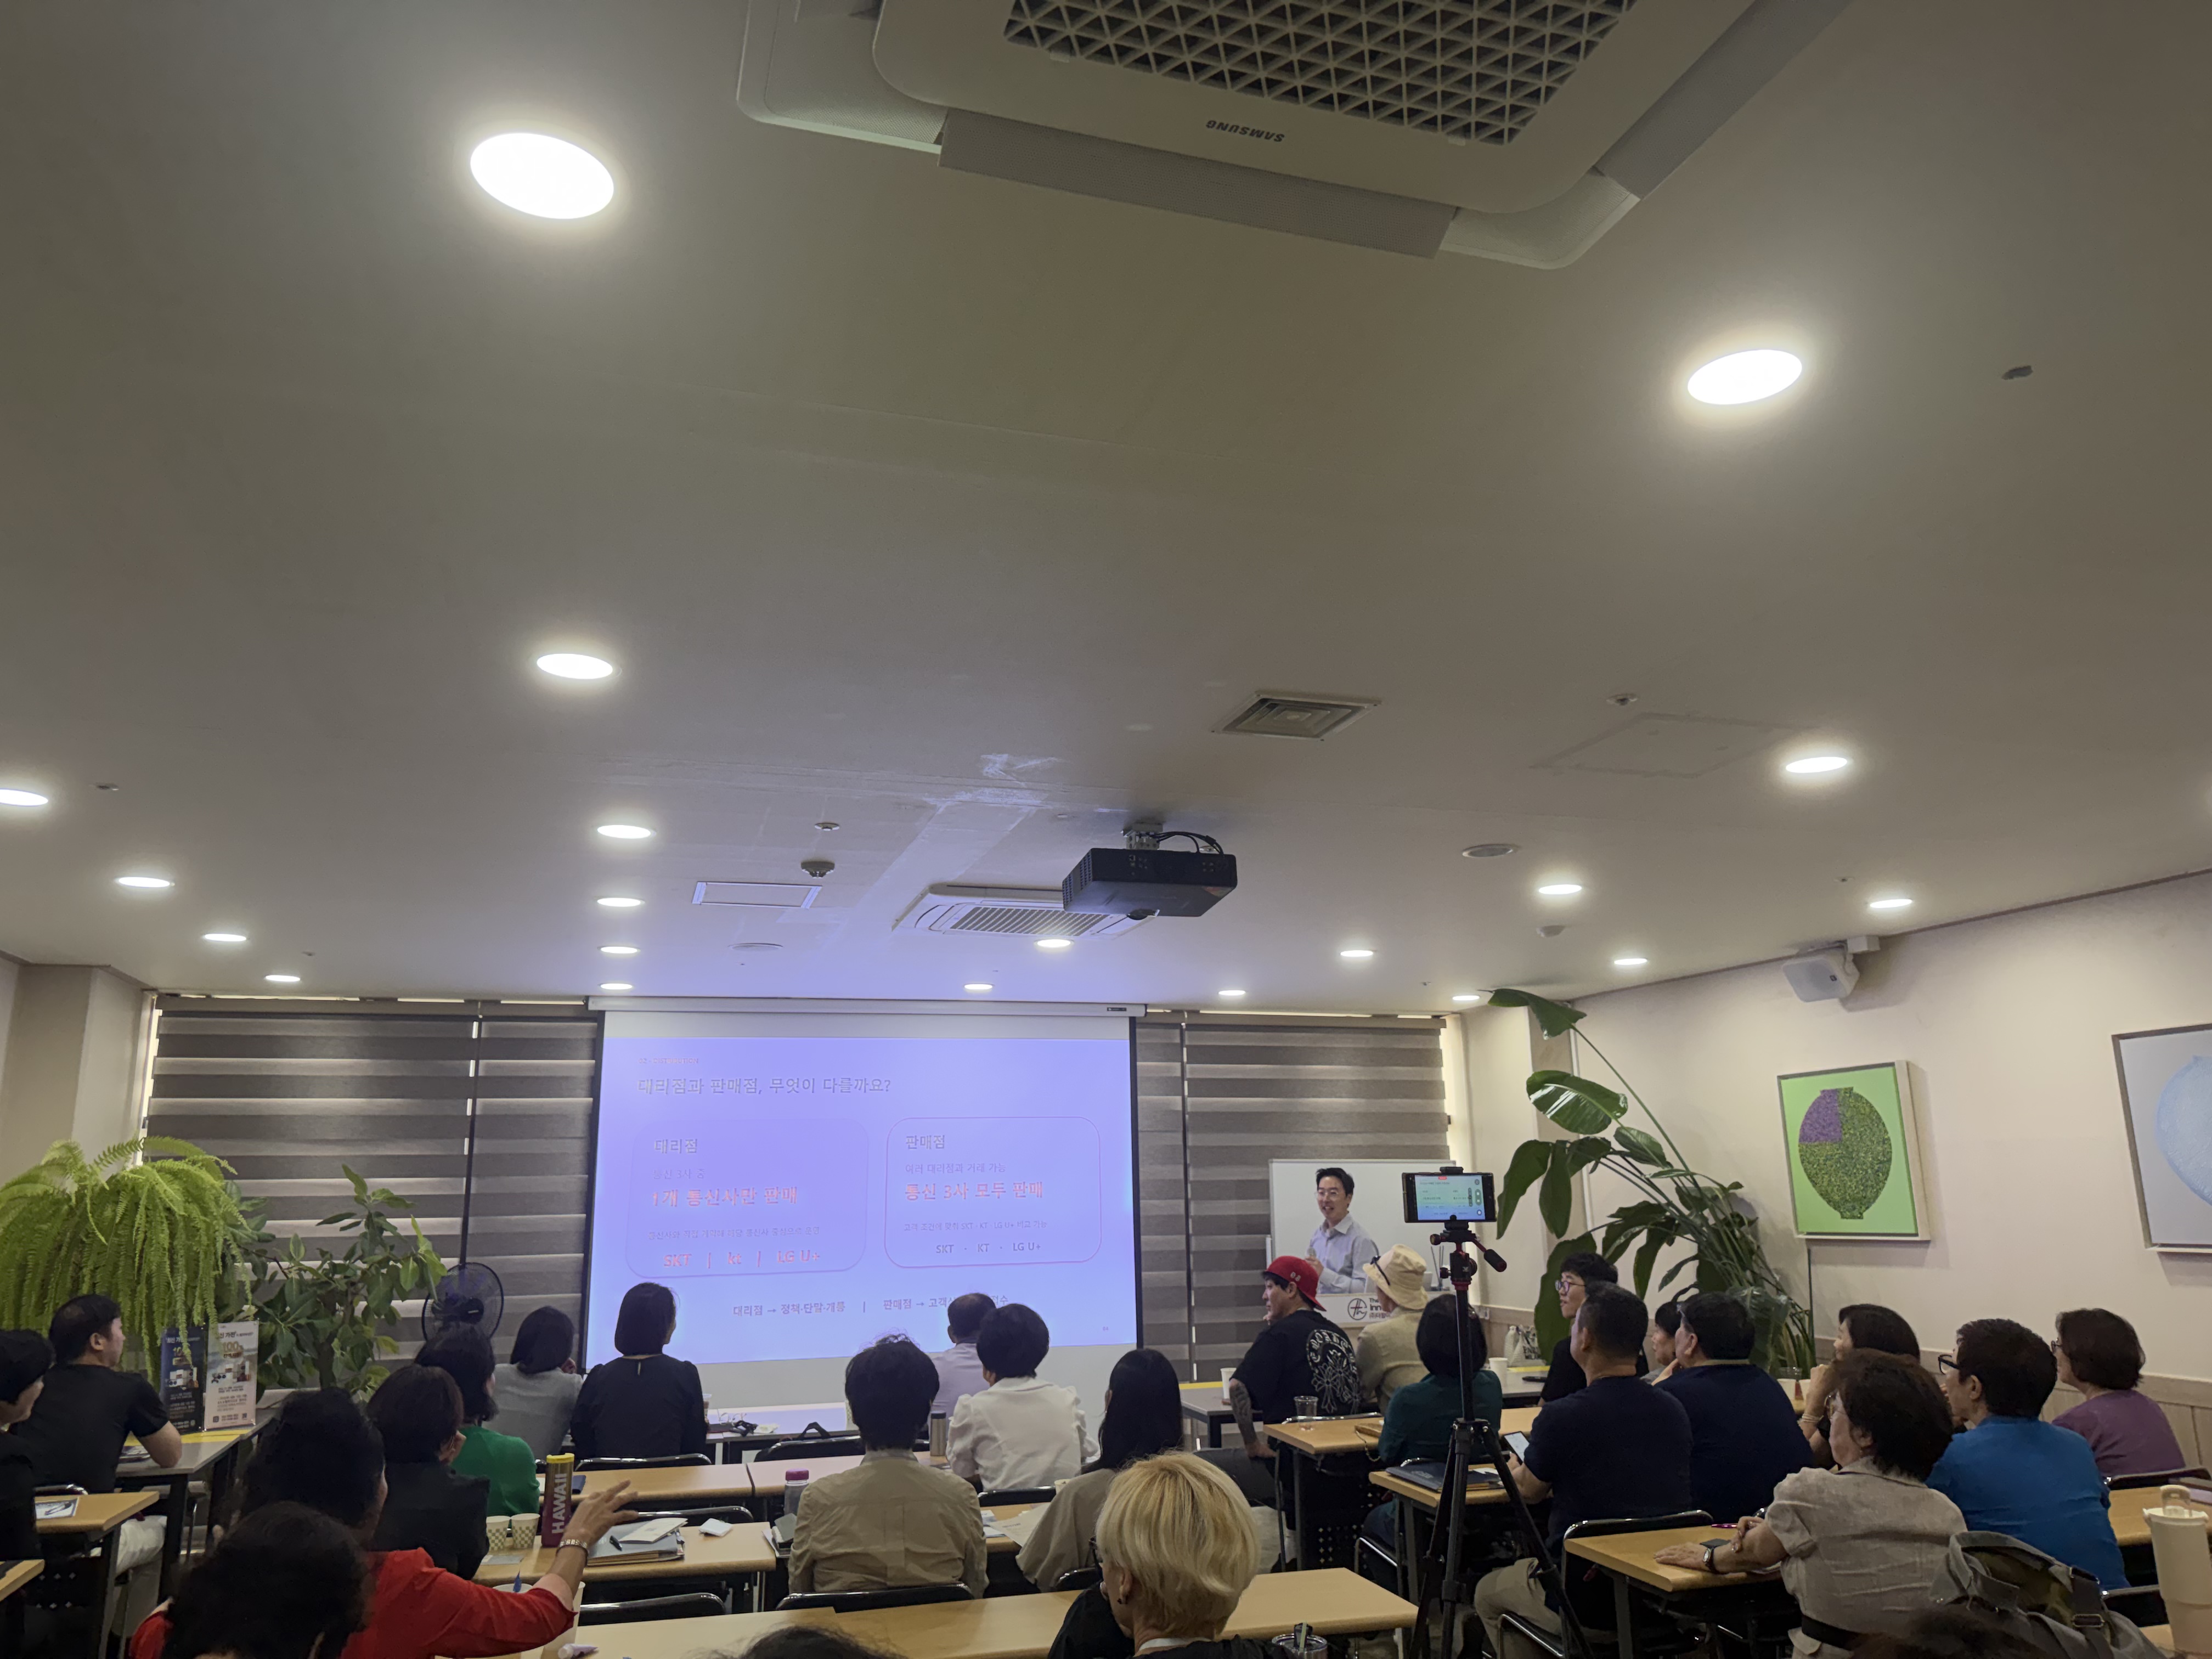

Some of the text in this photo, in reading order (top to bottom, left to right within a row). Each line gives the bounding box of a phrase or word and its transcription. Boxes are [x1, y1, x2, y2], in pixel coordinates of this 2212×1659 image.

[1206, 120, 1285, 142] SAMSUNG
[637, 1077, 891, 1095] 대리점과 판매점, 무엇이 다를까요?
[654, 1138, 698, 1154] 대리점
[906, 1135, 945, 1150] 판매점
[652, 1168, 706, 1180] 통신 3사 중
[905, 1162, 1006, 1175] 여러 대리점과 거래 가능
[652, 1186, 798, 1207] 1개 통신사만 판매
[905, 1181, 1043, 1201] 통신 3사 모두 판매
[746, 1228, 769, 1237] 통신사
[904, 1223, 918, 1232] 고객
[1017, 1221, 1031, 1229] 비교
[1033, 1220, 1048, 1229] 가능
[936, 1242, 1041, 1254] SKT KT LG U+
[663, 1249, 820, 1267] SKT kt LG U+
[733, 1305, 763, 1317] 대리점
[883, 1298, 912, 1311] 판매점
[551, 1473, 567, 1534] HAWAII
